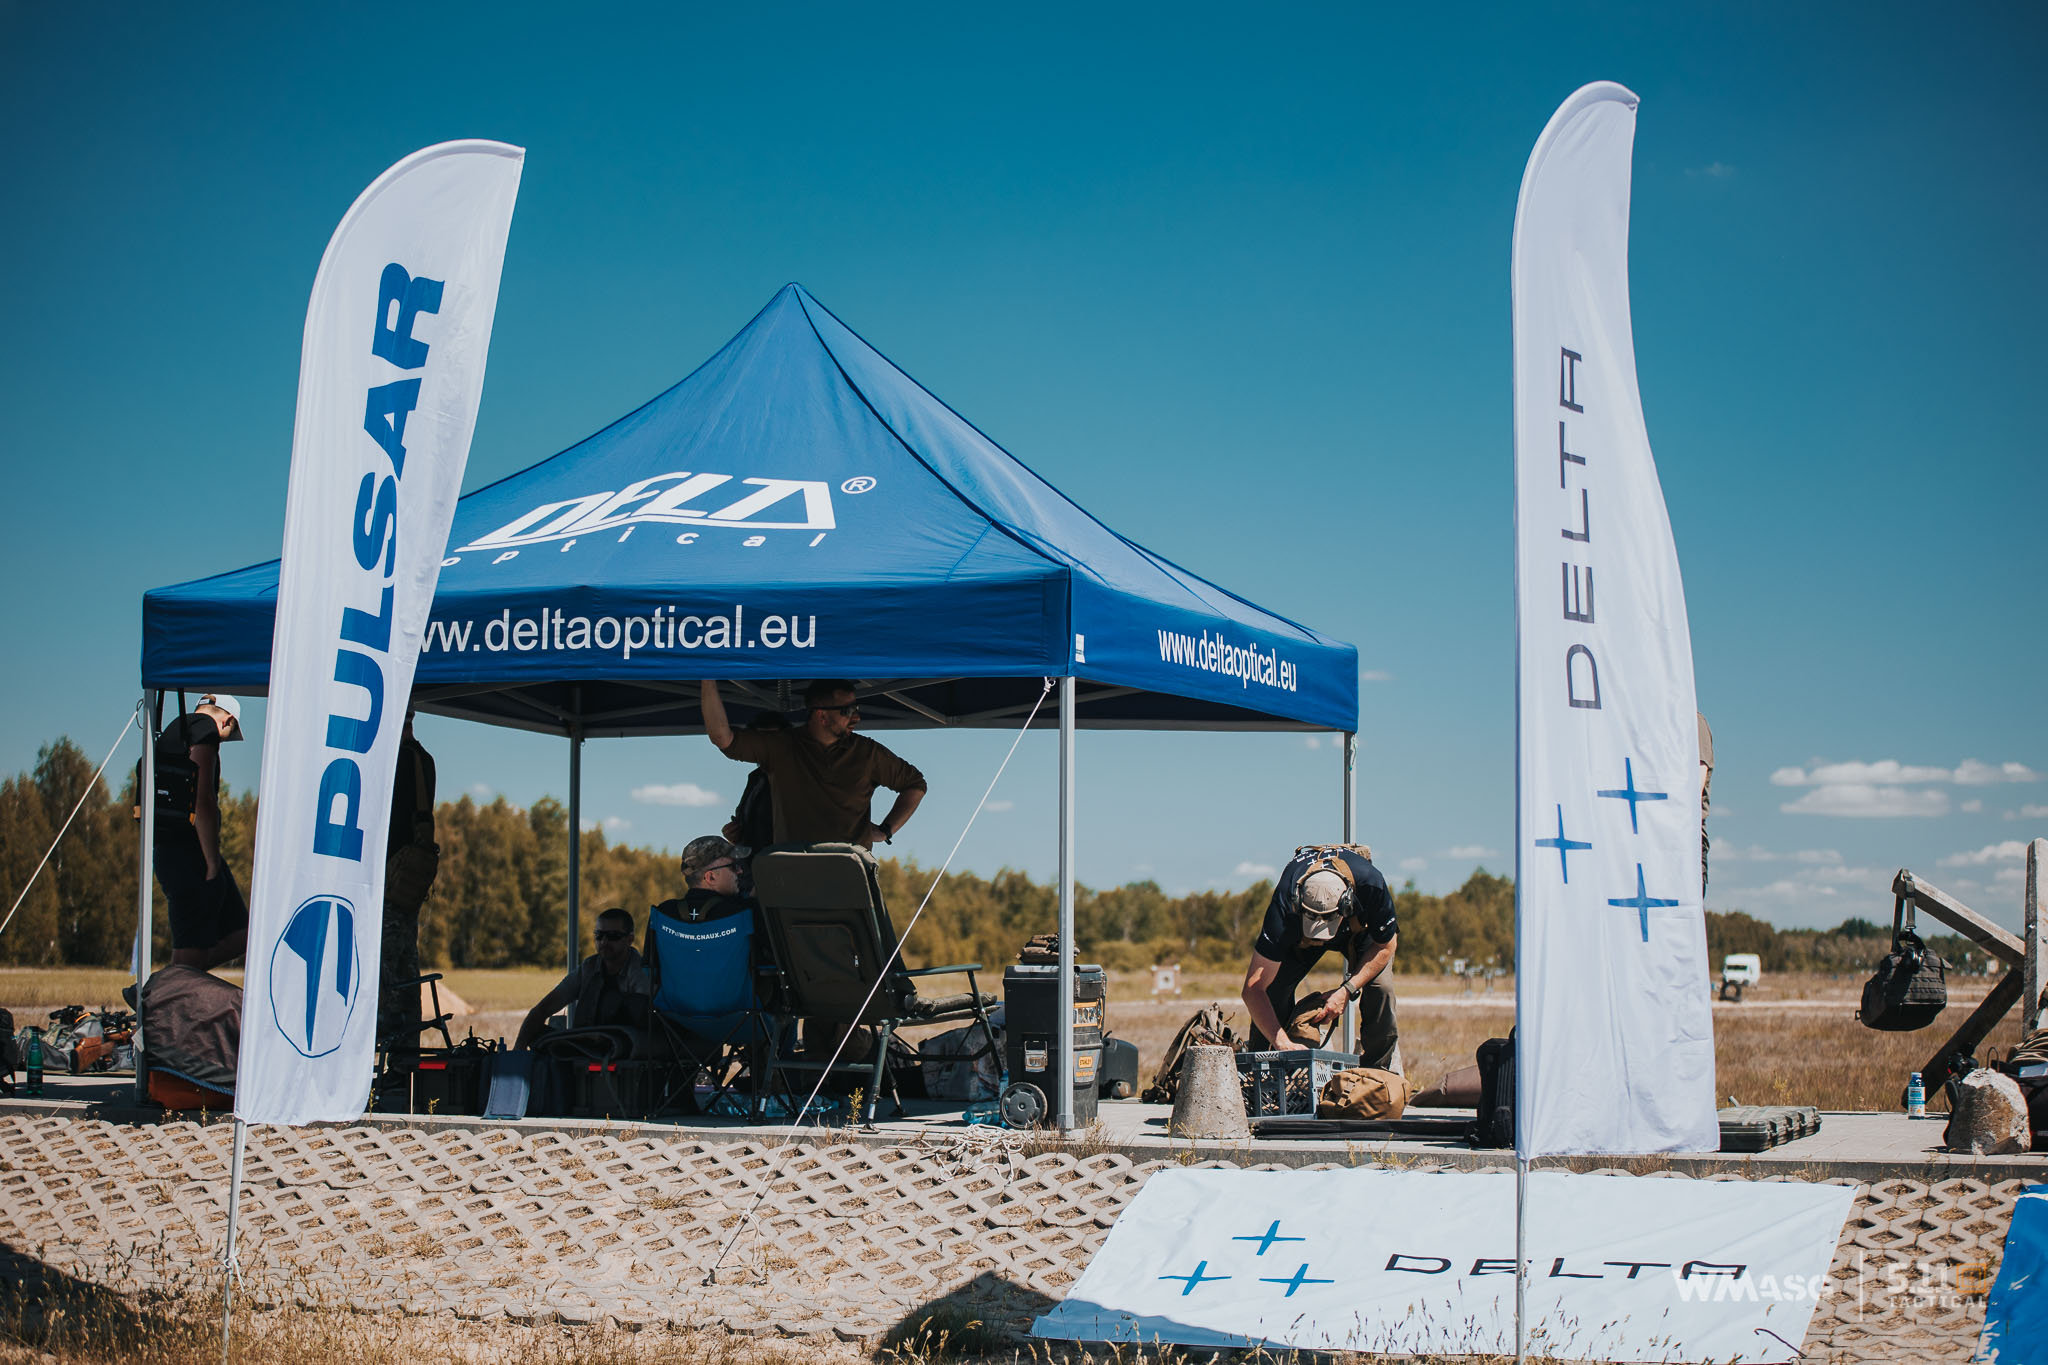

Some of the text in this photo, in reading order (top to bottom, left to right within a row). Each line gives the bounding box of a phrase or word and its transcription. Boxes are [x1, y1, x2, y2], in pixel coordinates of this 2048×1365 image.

[440, 526, 826, 567] optical
[454, 472, 836, 553] DELTA
[1559, 346, 1602, 710] DELTA
[313, 262, 445, 862] PULSAR
[1157, 629, 1297, 692] www.deltaoptical.eu
[1385, 1253, 1747, 1280] DELTA
